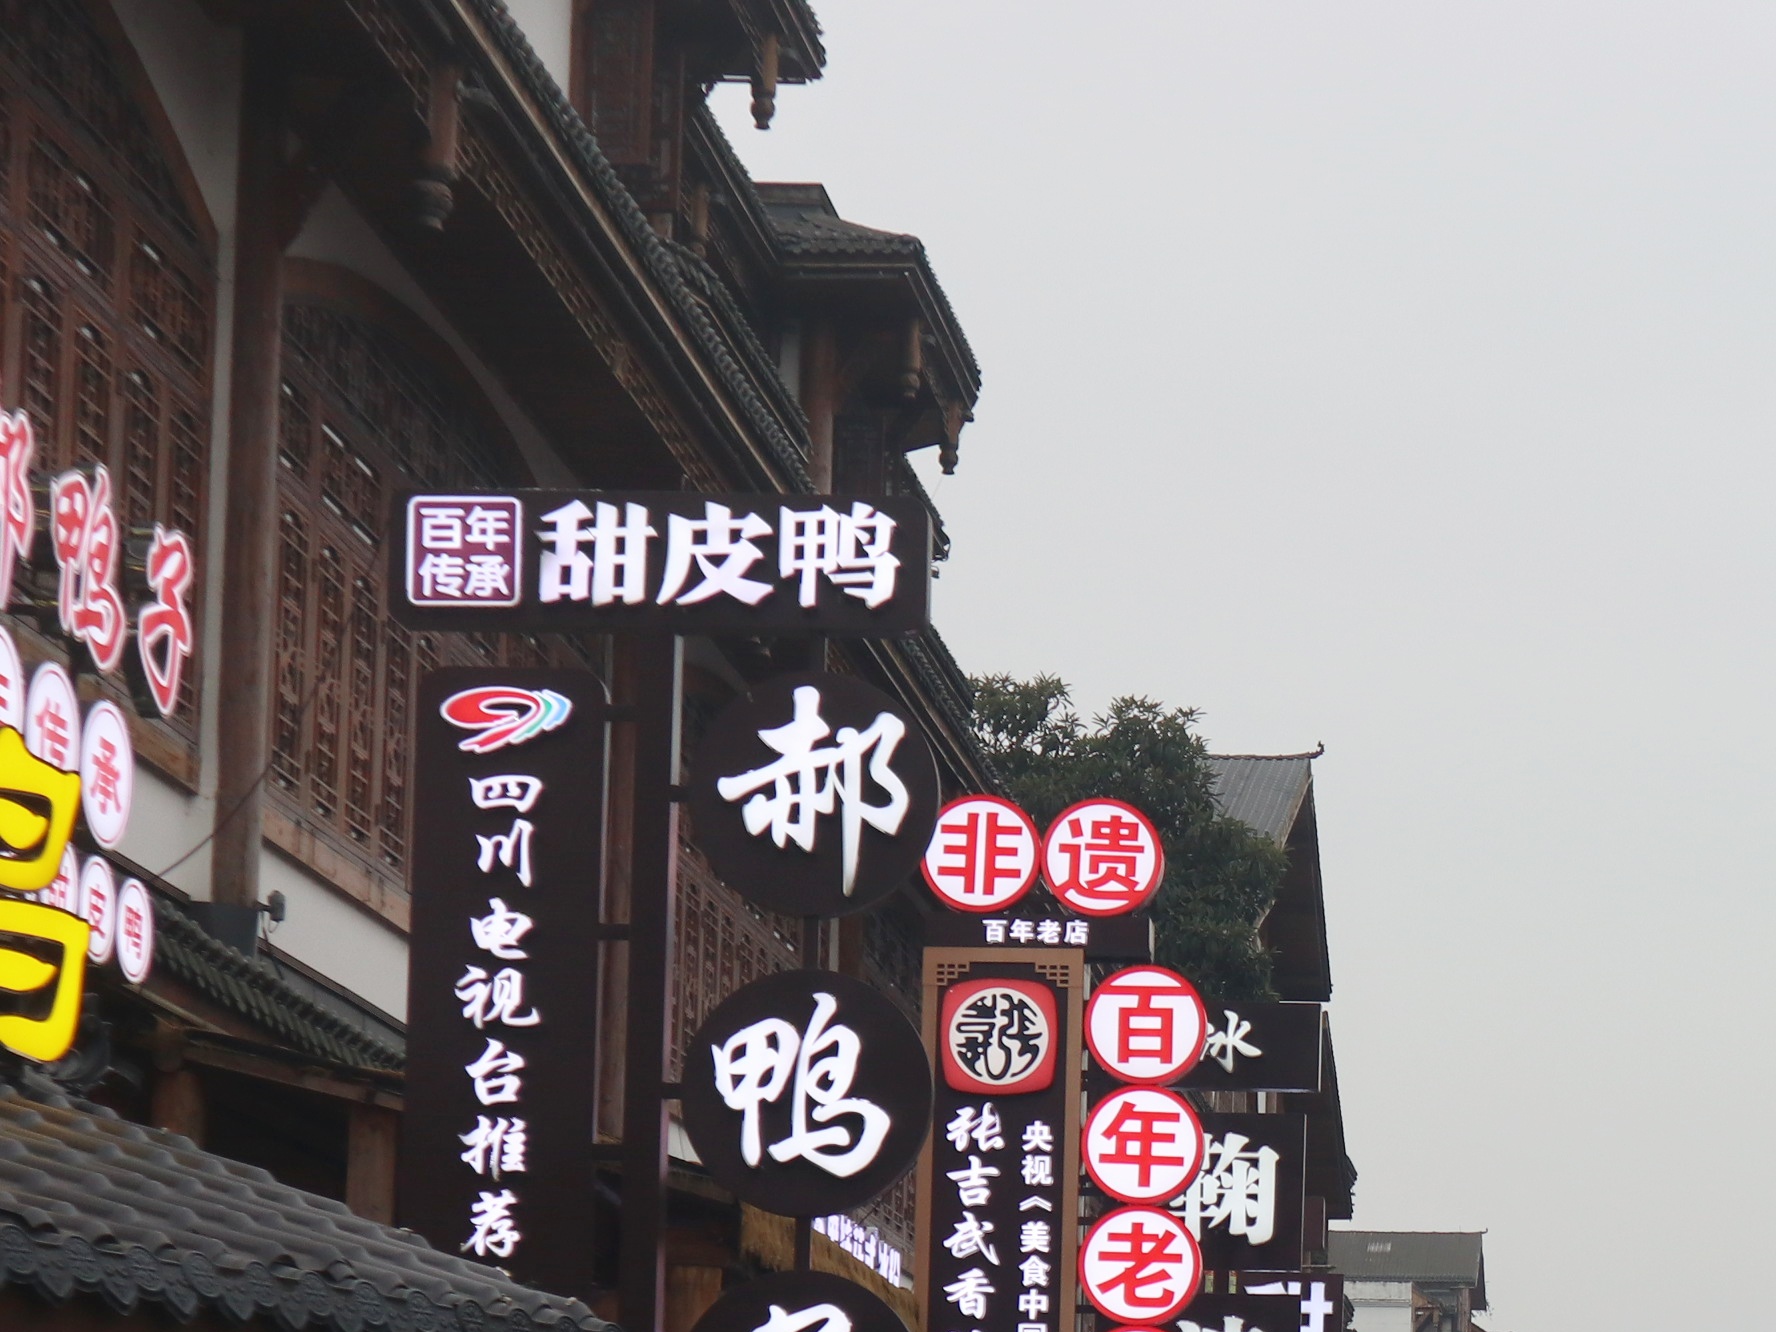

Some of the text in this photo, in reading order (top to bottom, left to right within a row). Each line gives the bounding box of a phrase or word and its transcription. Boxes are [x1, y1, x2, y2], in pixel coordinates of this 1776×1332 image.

[420, 506, 509, 550] 百年
[536, 501, 901, 609] 甜皮鸭
[418, 553, 509, 597] 传承
[937, 813, 1145, 905] 非遗
[982, 919, 1089, 946] 百年老店
[455, 774, 543, 1257] 四川电视台推荐
